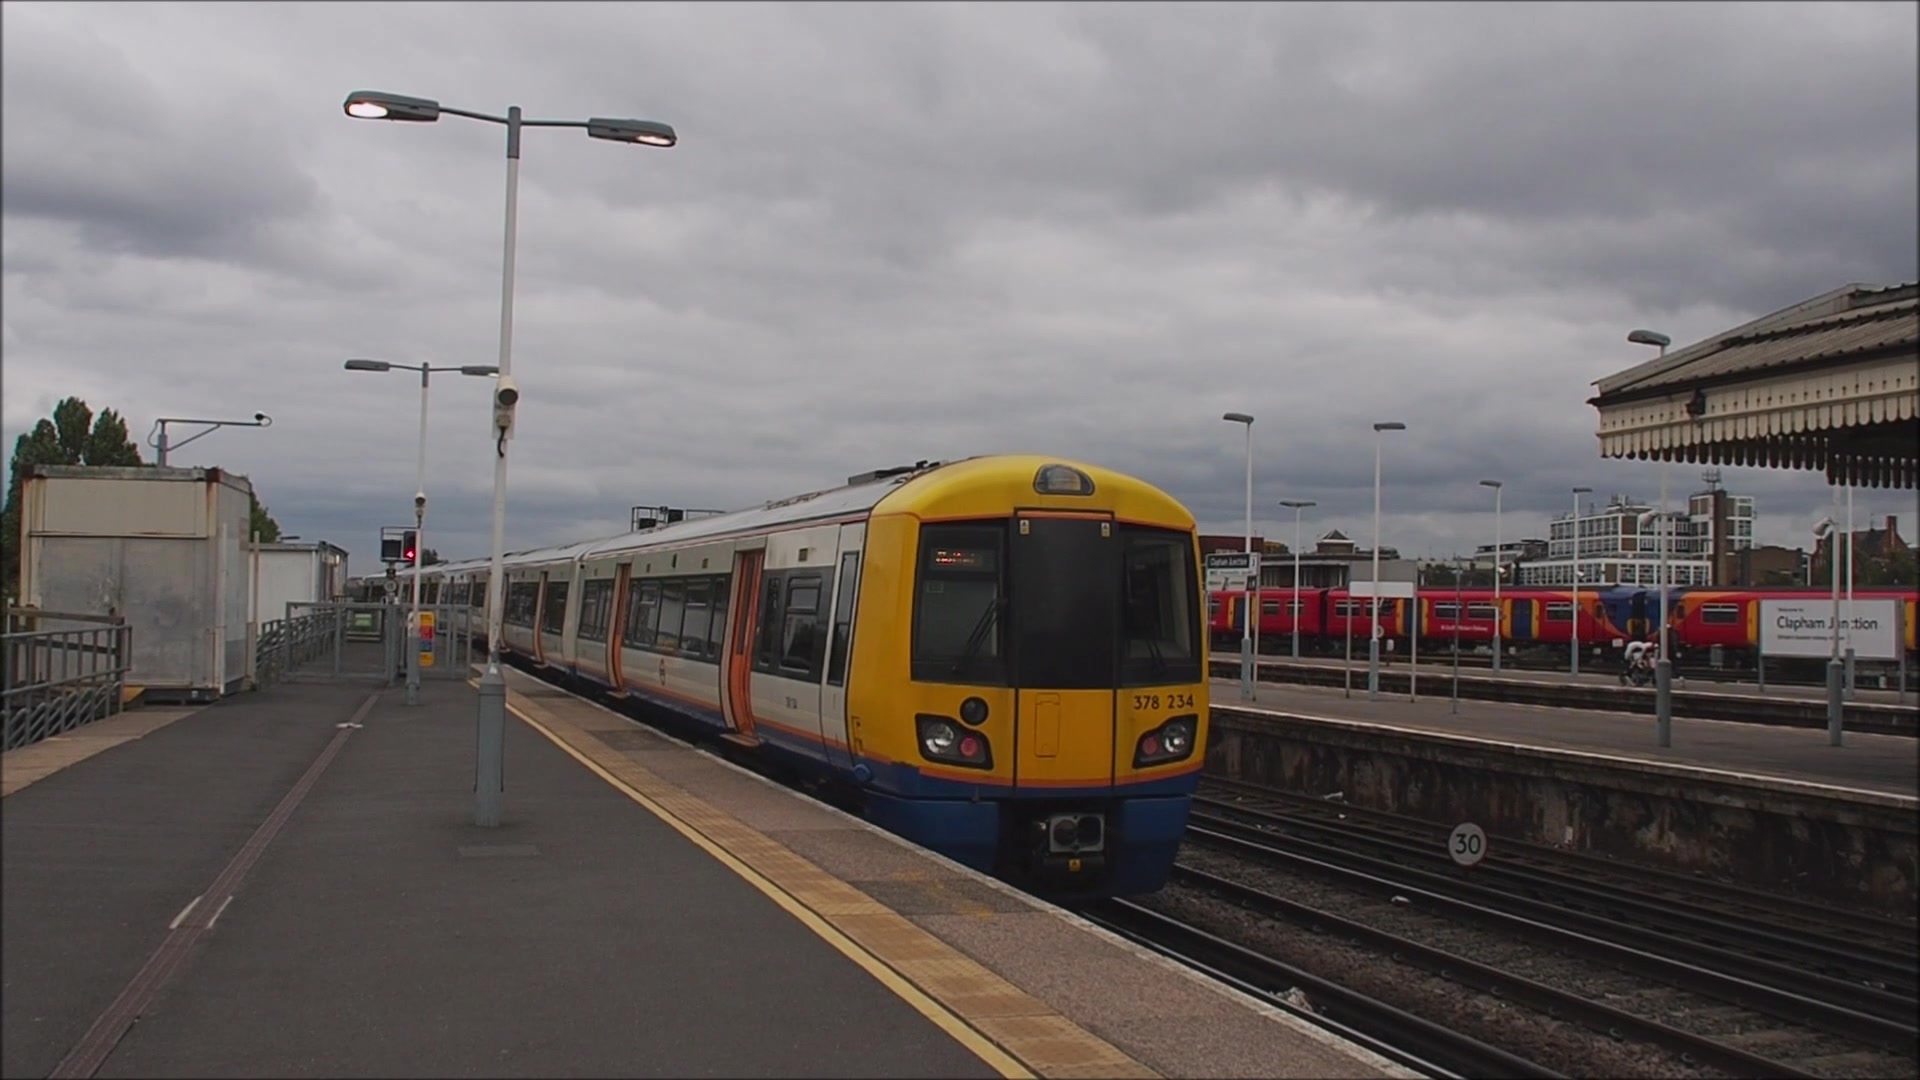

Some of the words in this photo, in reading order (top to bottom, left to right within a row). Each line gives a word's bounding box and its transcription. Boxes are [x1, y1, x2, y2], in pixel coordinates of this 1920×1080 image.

[1777, 615, 1825, 632] Clapham
[1133, 695, 1160, 710] 378
[1168, 694, 1194, 709] 234
[1455, 833, 1481, 854] 30
